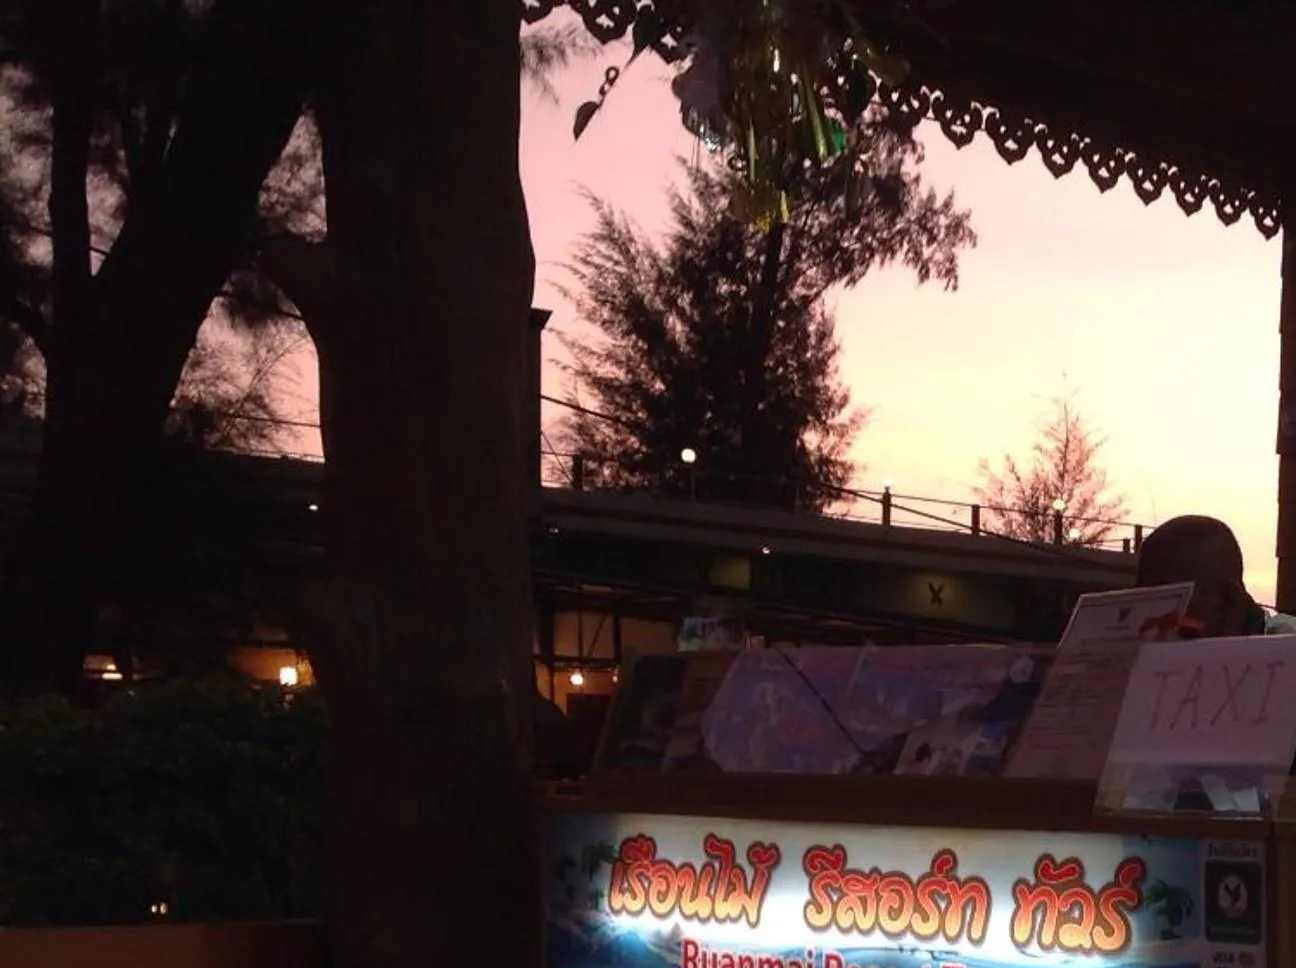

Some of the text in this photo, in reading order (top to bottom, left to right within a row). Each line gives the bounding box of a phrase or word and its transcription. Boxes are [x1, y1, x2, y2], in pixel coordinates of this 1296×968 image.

[1151, 660, 1286, 731] TAXI
[607, 832, 1146, 954] เรือนไม้ รีสอร์ท ทัวร์
